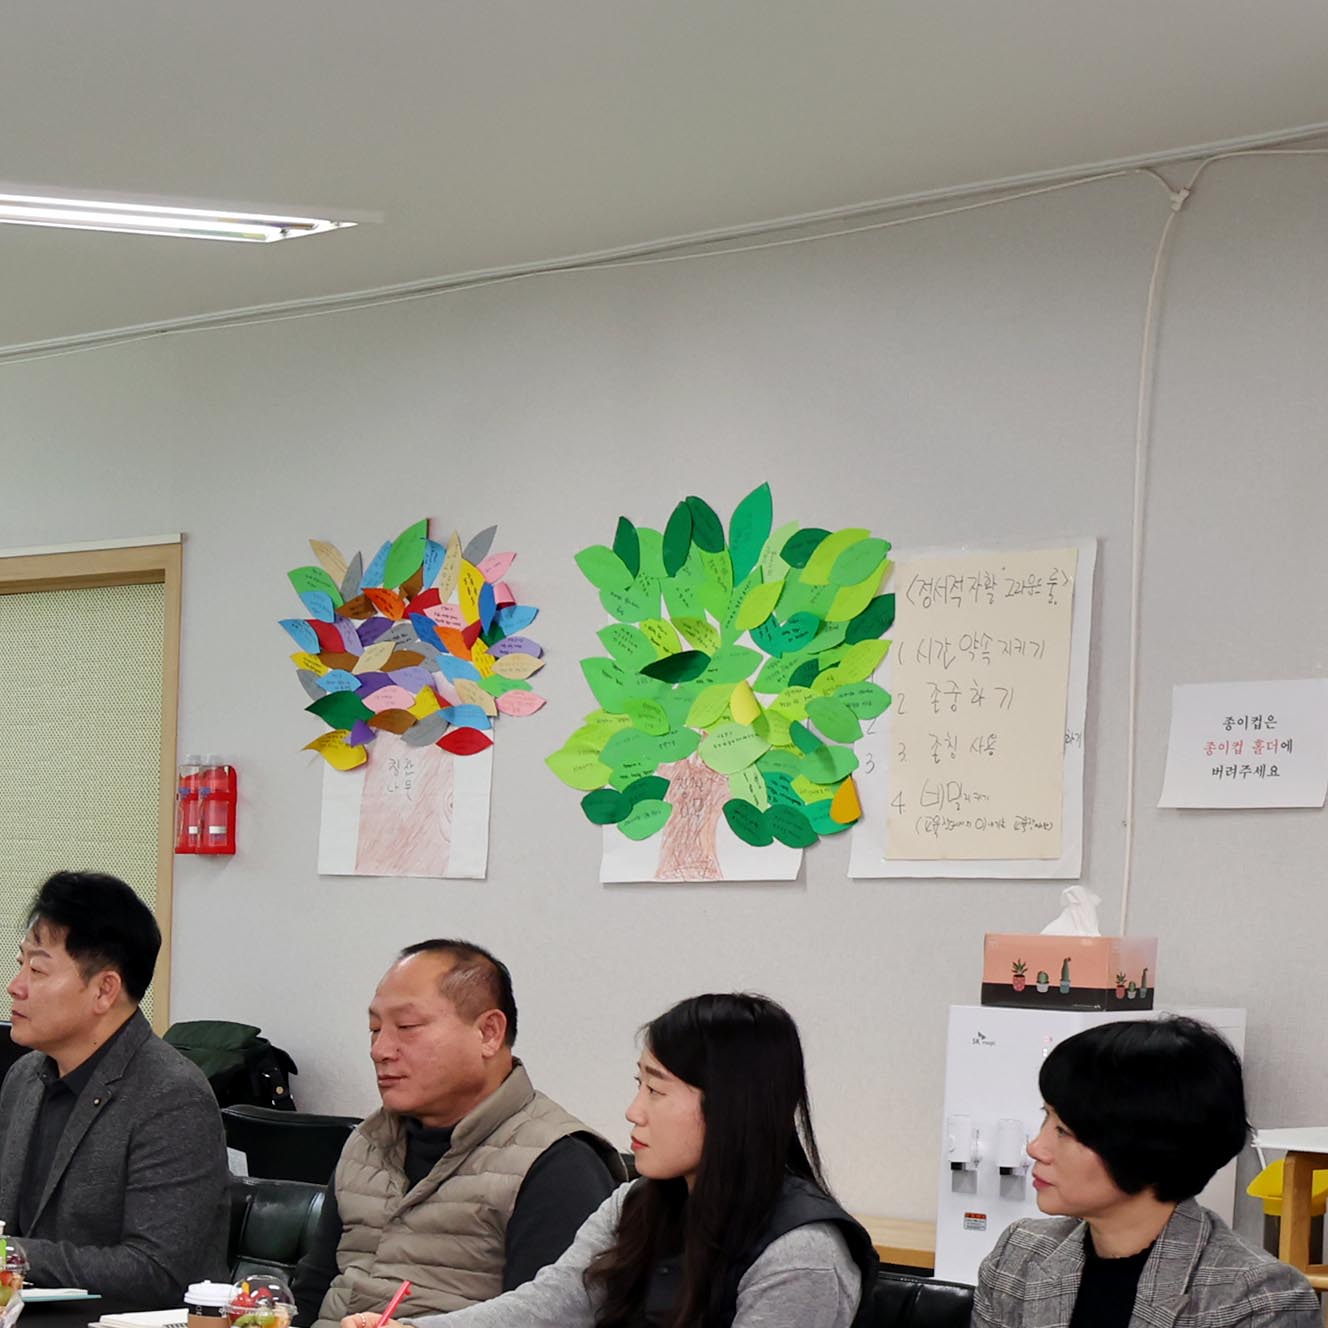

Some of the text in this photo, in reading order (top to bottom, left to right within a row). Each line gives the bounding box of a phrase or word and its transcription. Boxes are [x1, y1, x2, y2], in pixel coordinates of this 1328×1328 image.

[917, 637, 956, 670] 시간
[959, 632, 993, 665] 약속
[998, 639, 1045, 660] 지키기
[1223, 714, 1278, 731] 종이컵은
[969, 733, 998, 756] 사용
[1204, 738, 1293, 756] 종이컵 홀더에
[1211, 763, 1281, 780] 버려주세요
